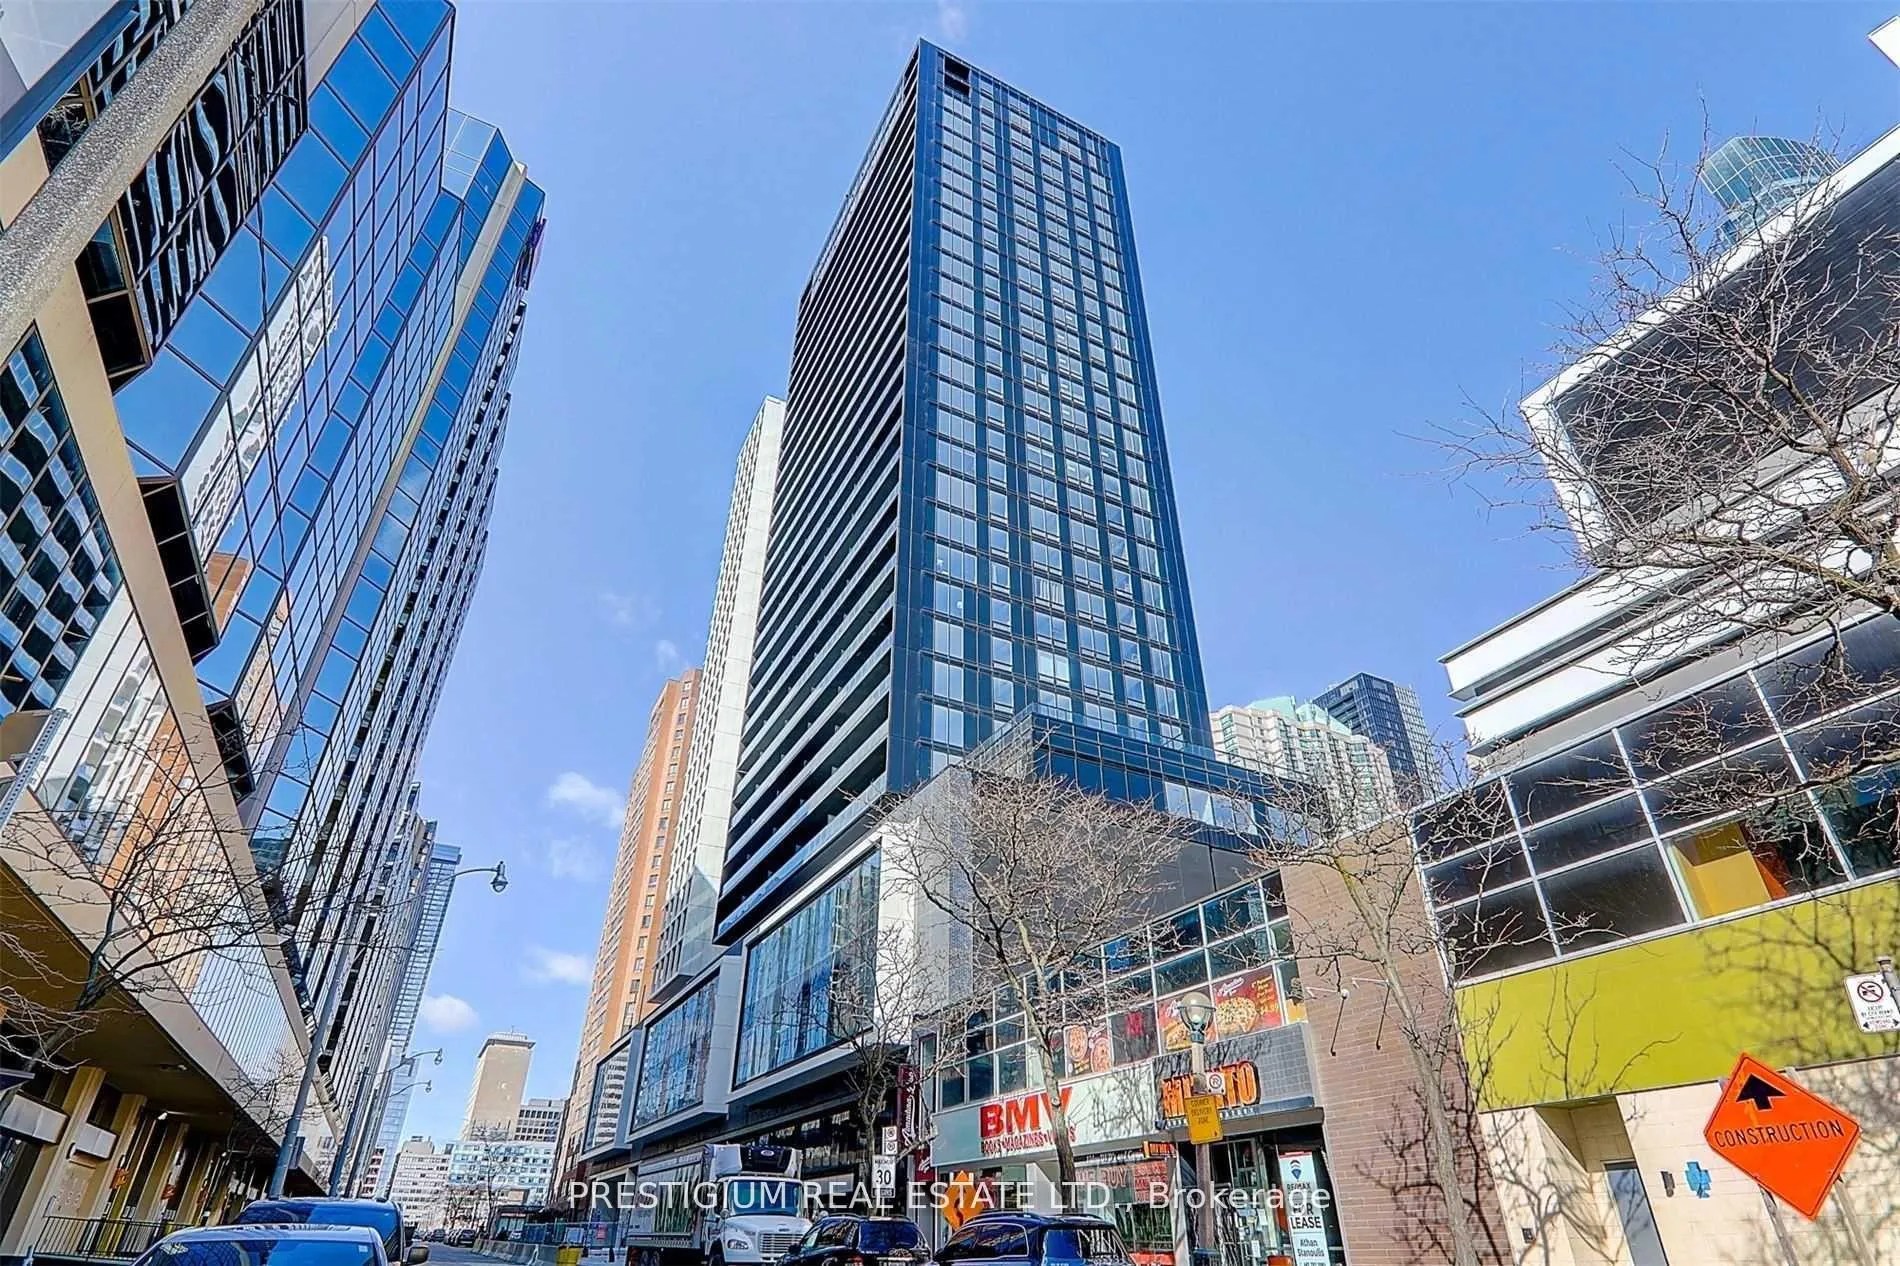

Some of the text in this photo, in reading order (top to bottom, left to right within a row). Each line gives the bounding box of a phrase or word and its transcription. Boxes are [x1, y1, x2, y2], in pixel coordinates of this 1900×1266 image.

[1714, 1119, 1845, 1148] CONSTRUCTION
[875, 1169, 892, 1185] 30
[1290, 1216, 1322, 1230] LEASE
